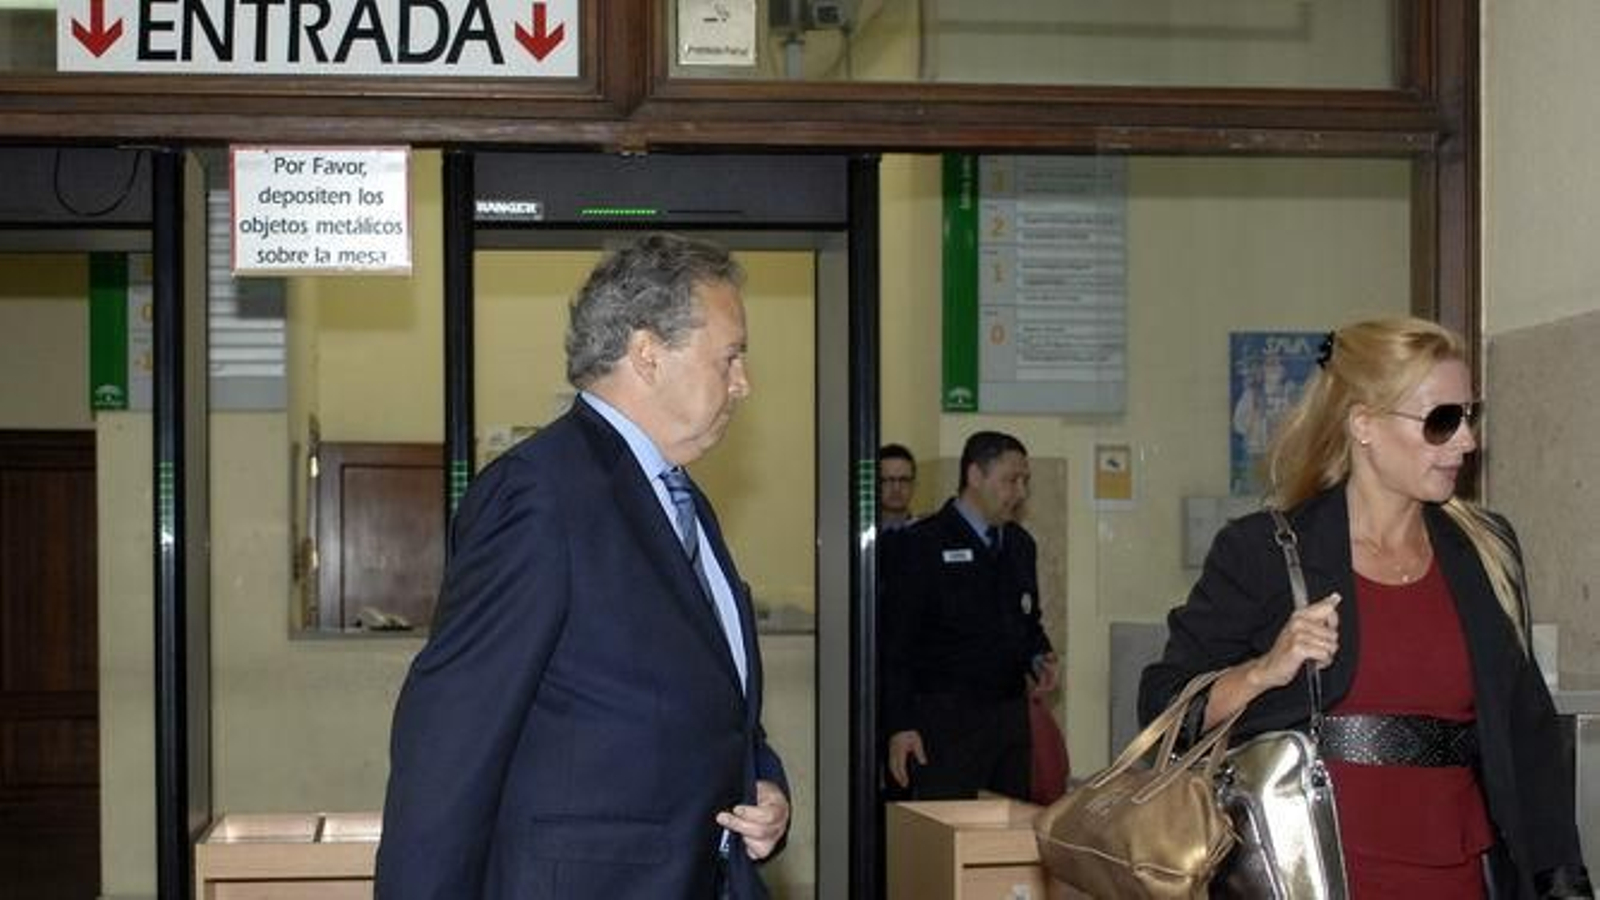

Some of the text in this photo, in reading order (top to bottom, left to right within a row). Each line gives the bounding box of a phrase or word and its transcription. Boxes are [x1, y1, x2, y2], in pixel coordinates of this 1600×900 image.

[136, 0, 506, 65] ENTRADA
[273, 156, 368, 177] Por Favor,
[257, 186, 385, 208] depositen los
[475, 200, 538, 215] RANGER
[238, 215, 404, 239] objetos metálicos
[256, 245, 387, 265] sobre la mesa
